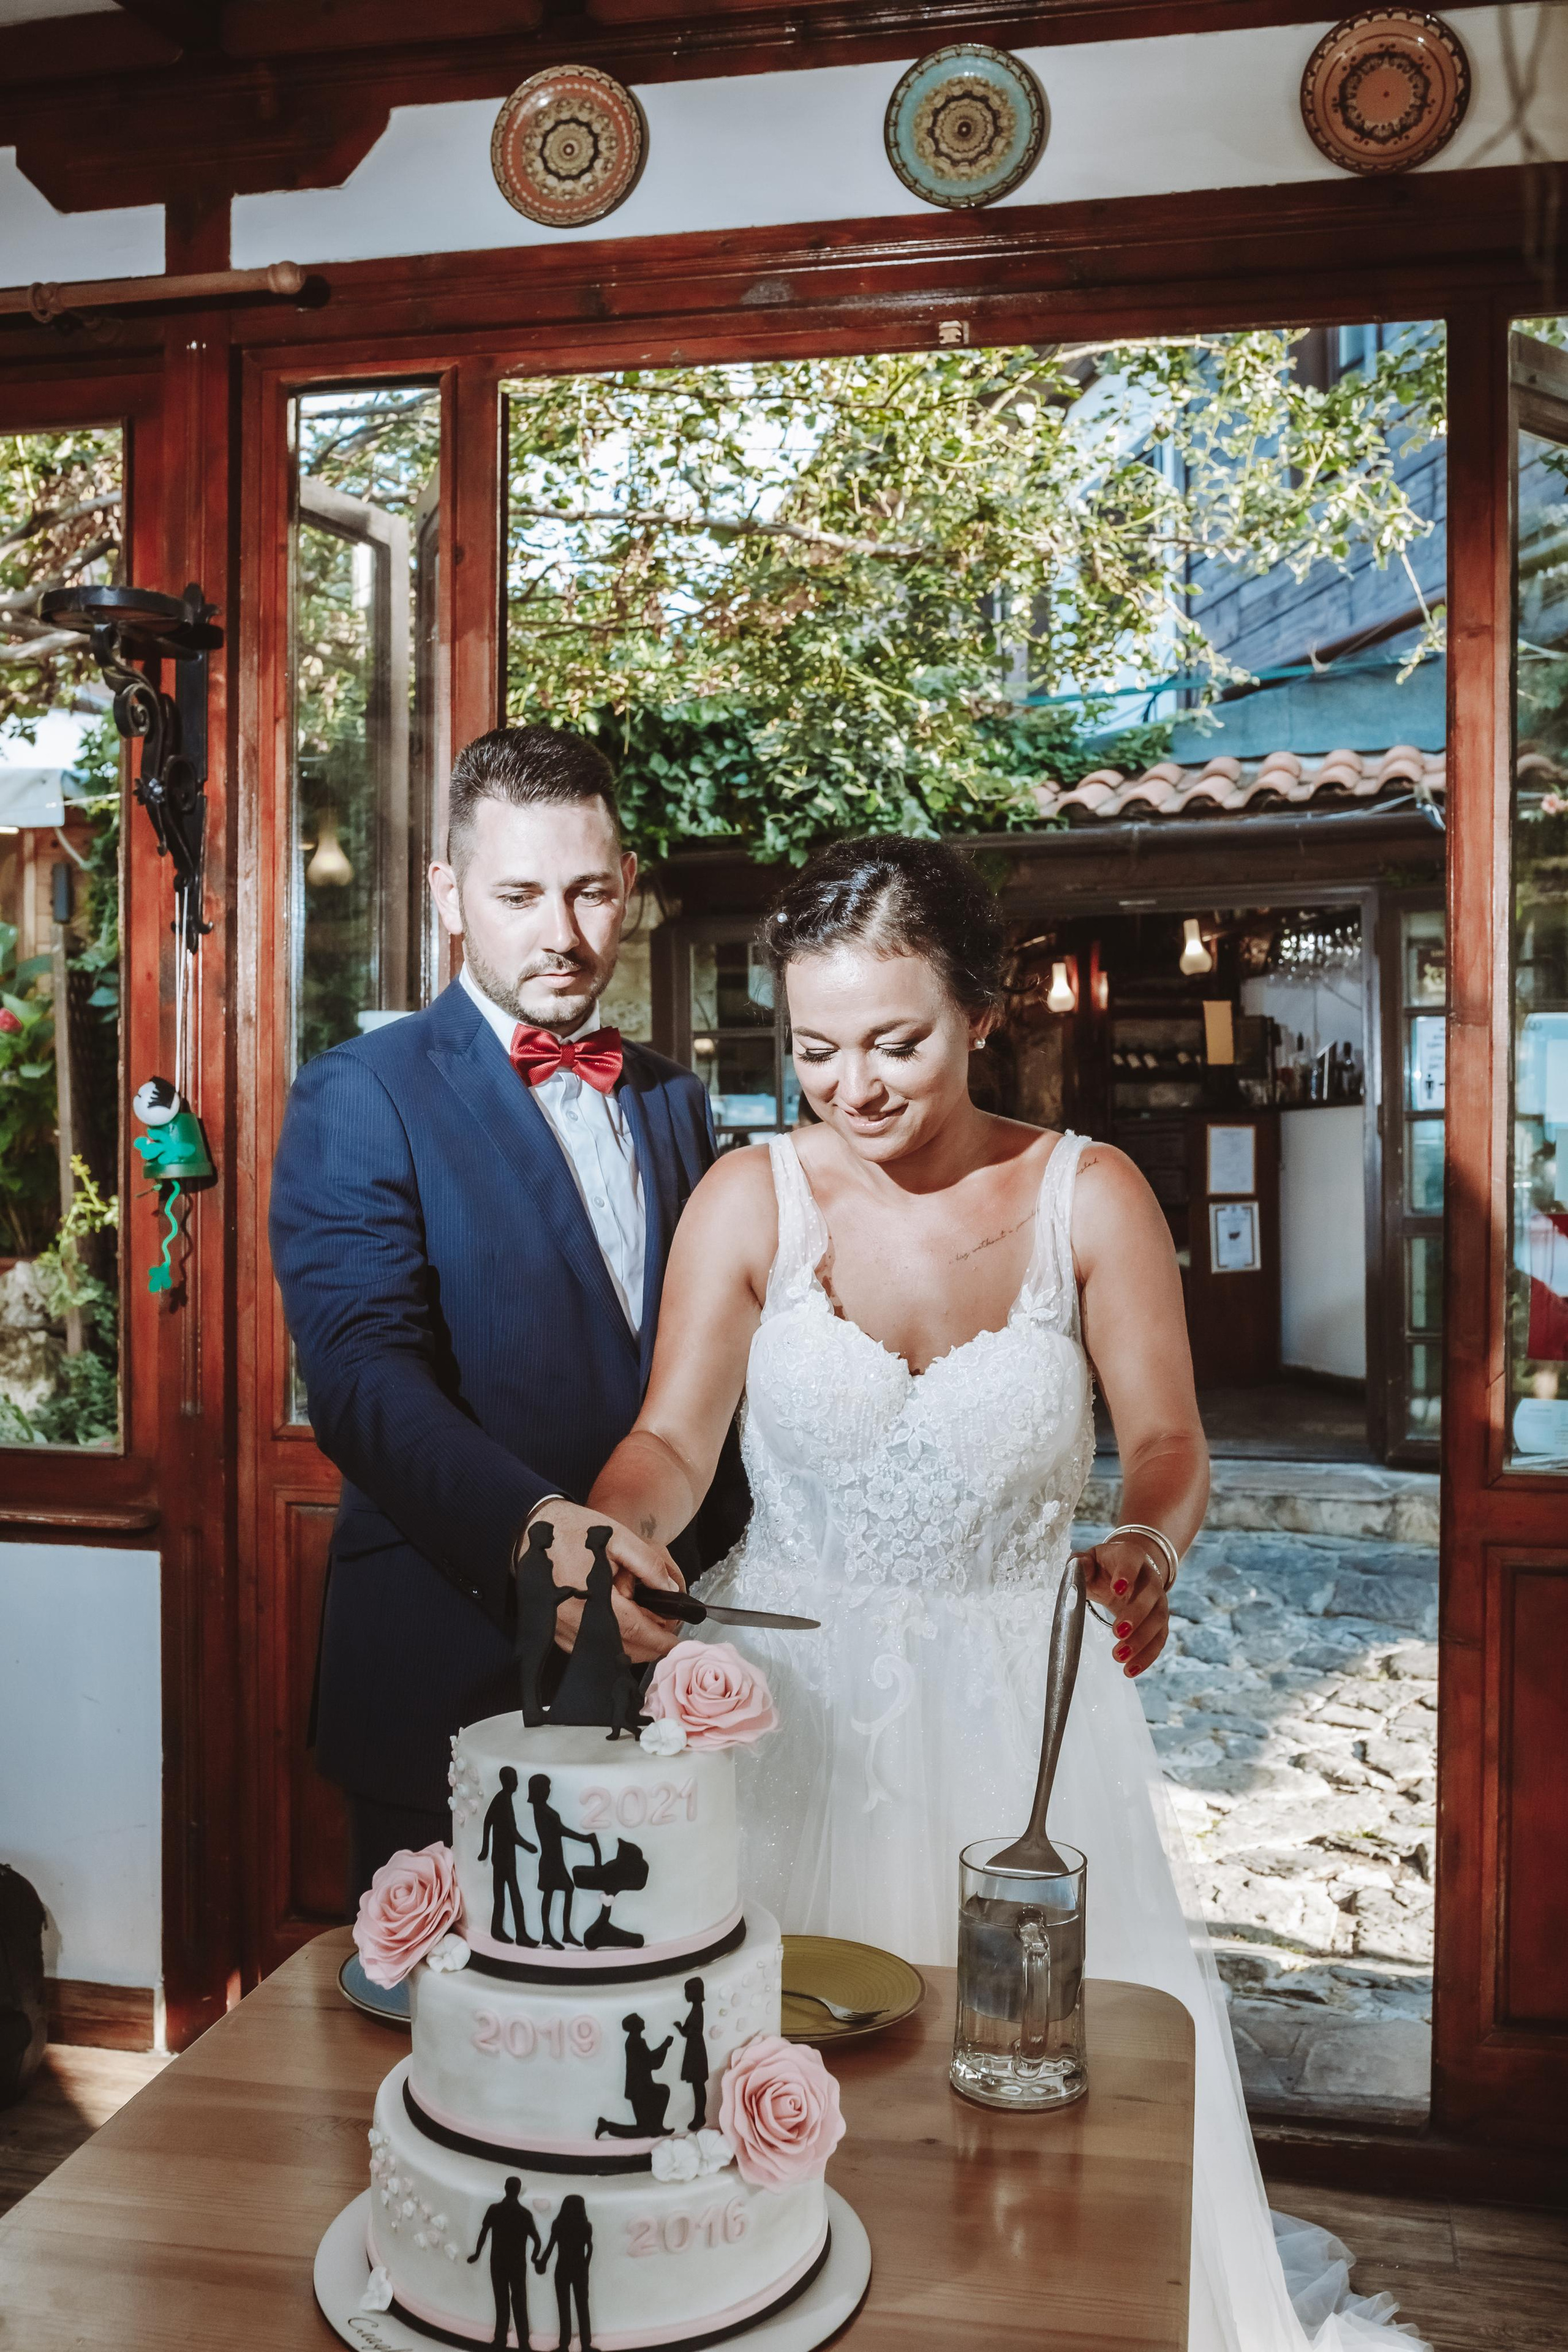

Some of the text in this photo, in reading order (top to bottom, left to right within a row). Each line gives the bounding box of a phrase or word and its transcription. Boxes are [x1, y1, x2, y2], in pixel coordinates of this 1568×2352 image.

[579, 1777, 698, 1829] 2021
[472, 2010, 601, 2059] 2019
[626, 2196, 748, 2257] 2016
